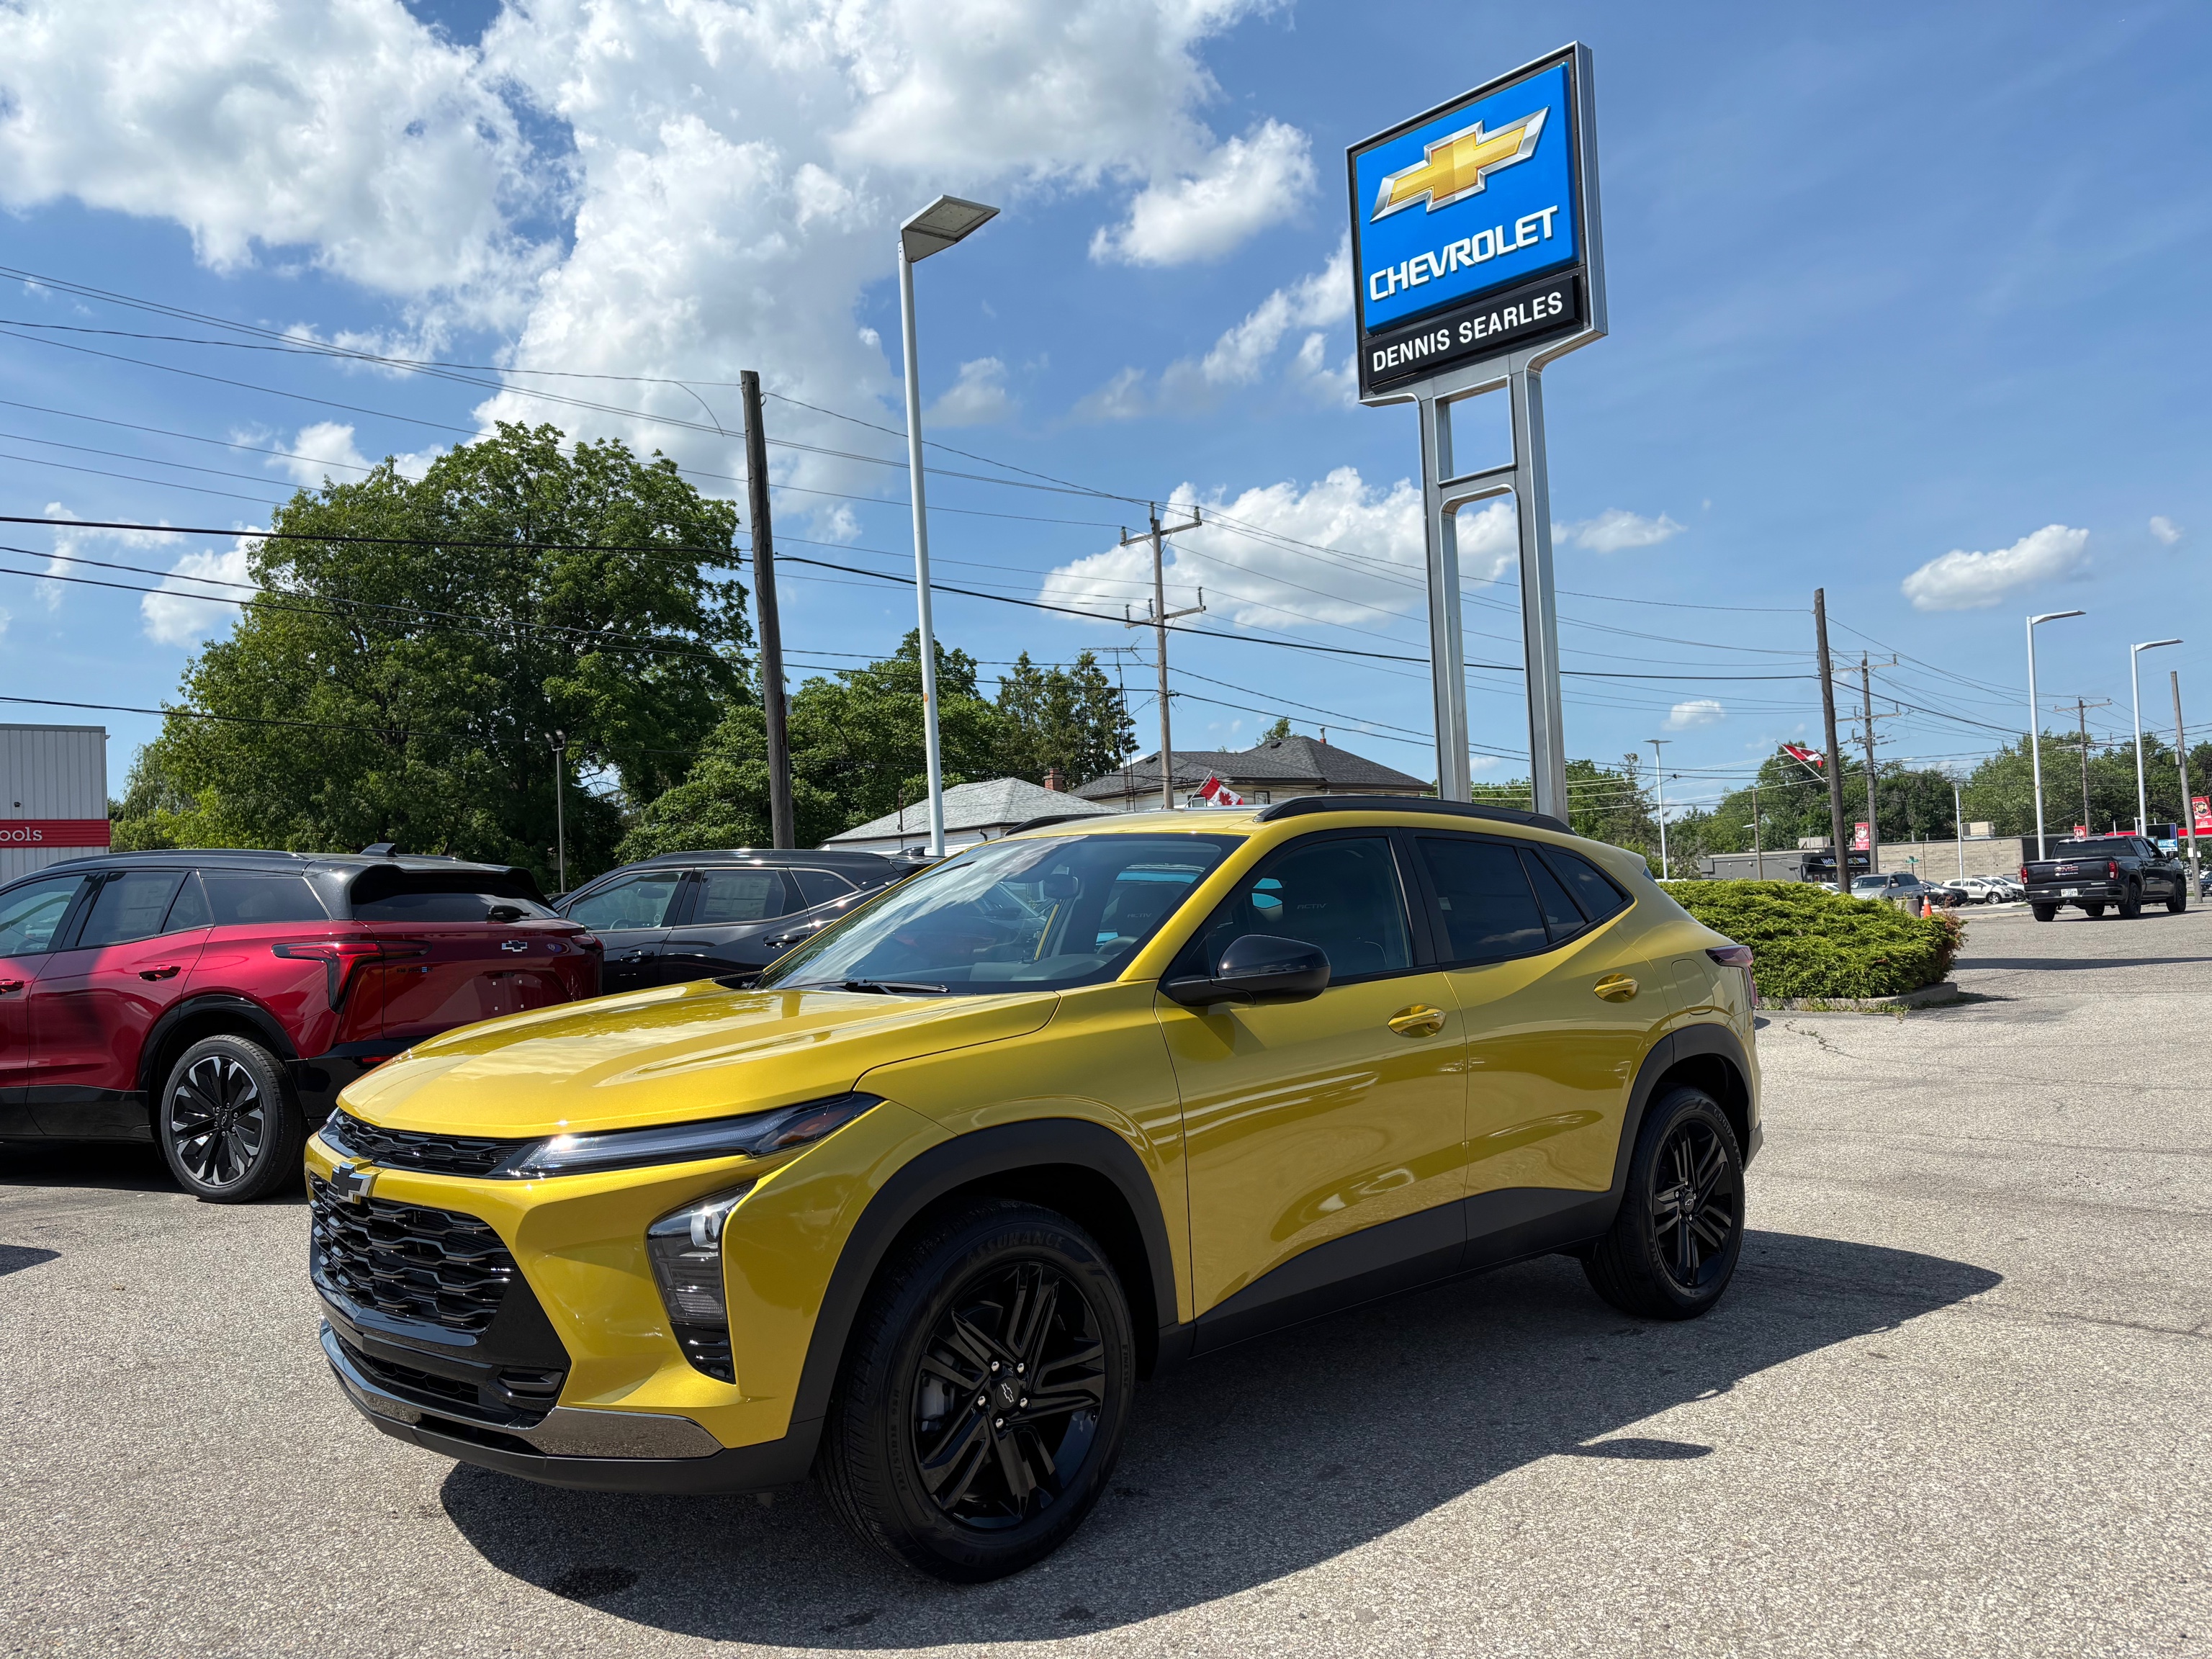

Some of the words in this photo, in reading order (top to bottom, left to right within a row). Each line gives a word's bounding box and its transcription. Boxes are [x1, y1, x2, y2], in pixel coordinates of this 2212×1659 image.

[1369, 204, 1559, 302] CHEVROLET
[1372, 329, 1451, 373] DENNIS
[1458, 292, 1563, 343] SEARLES
[0, 827, 42, 842] ools
[966, 1231, 1066, 1268] ASSURANCE
